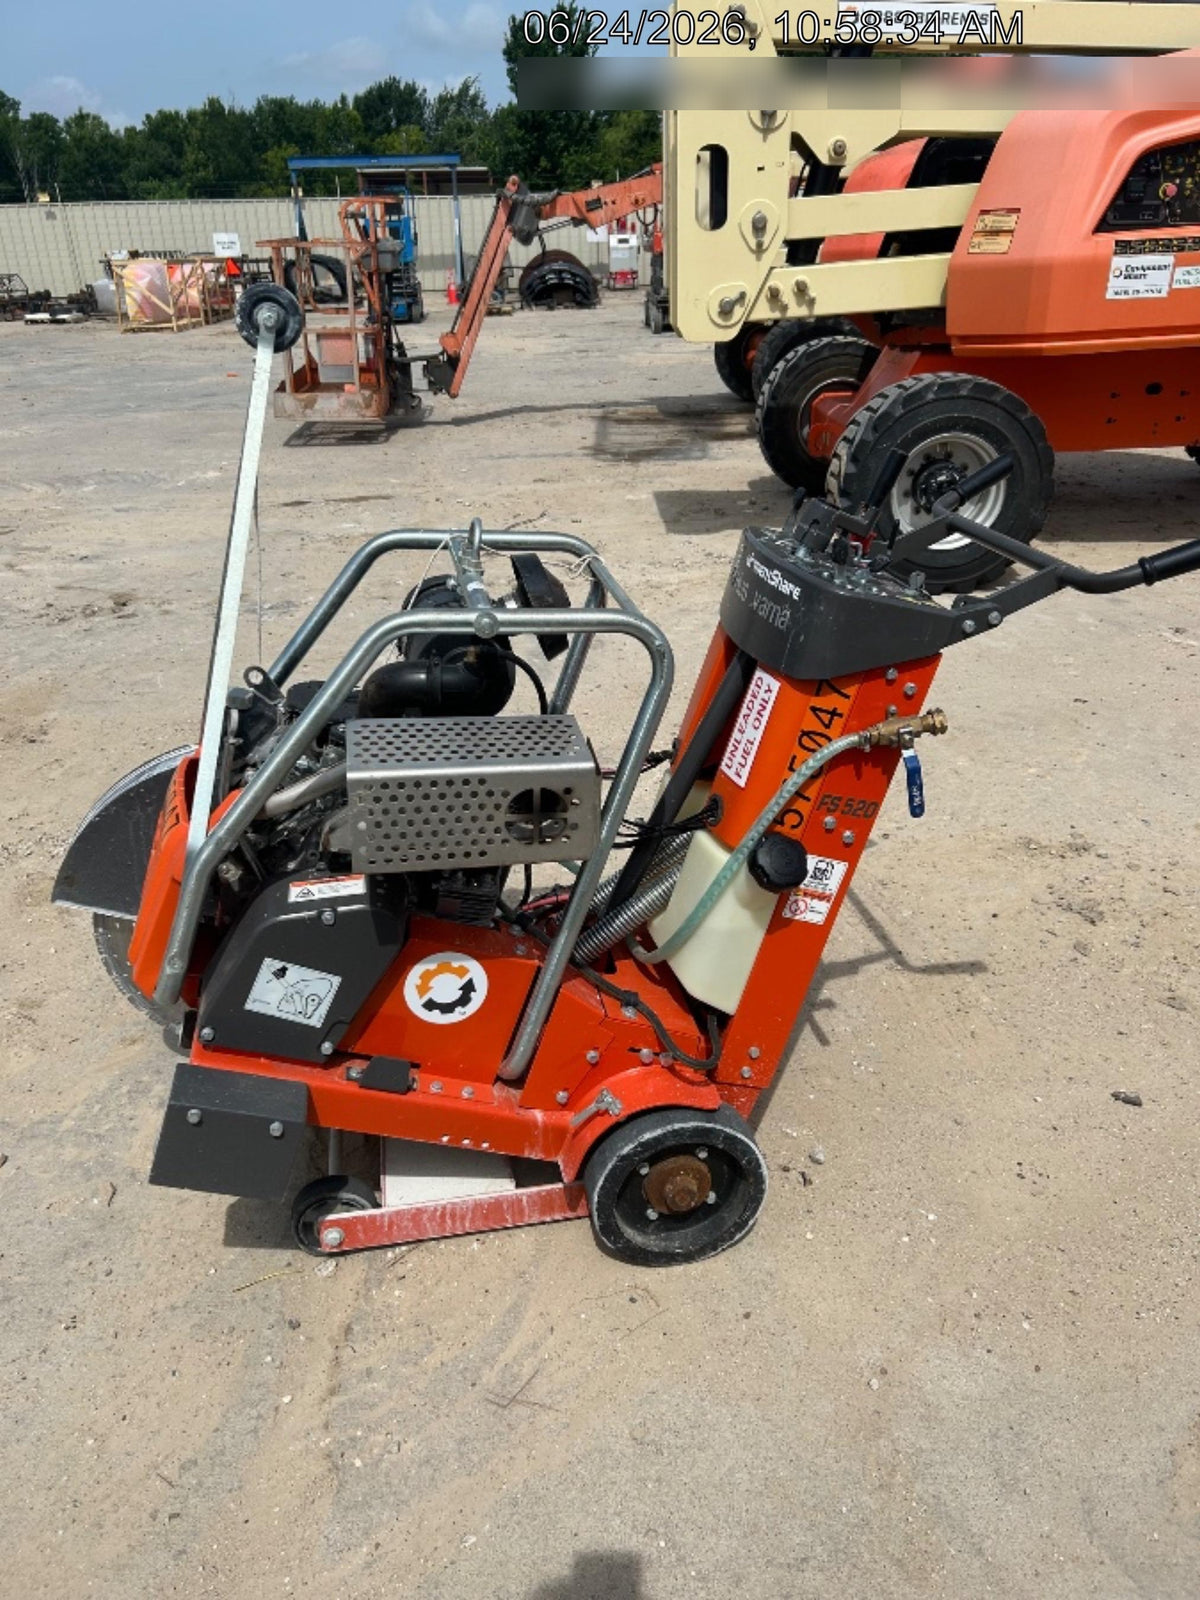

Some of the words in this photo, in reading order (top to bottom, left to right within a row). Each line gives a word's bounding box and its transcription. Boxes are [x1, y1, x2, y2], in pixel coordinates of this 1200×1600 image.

[724, 676, 764, 770] UNLEADED
[734, 736, 757, 780] FUEL
[753, 683, 774, 731] ONLY
[816, 793, 842, 814] FS
[841, 796, 880, 819] 520
